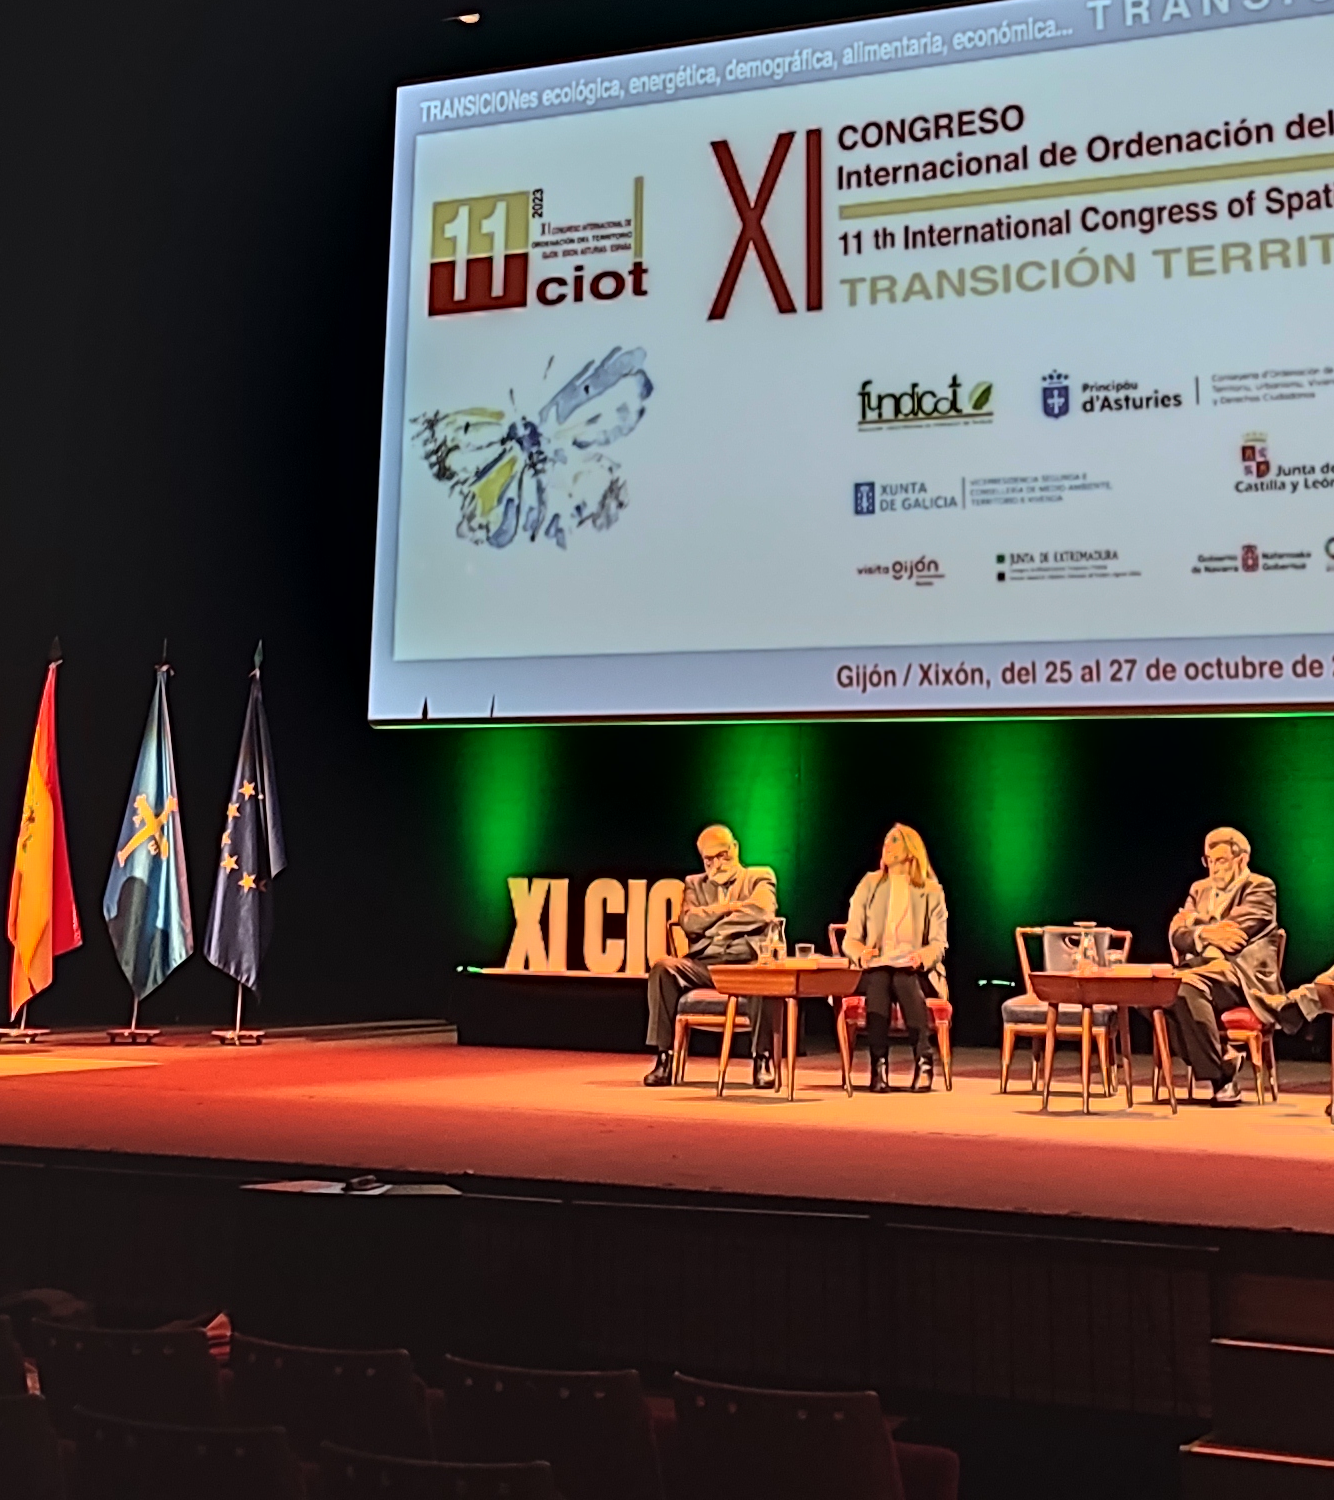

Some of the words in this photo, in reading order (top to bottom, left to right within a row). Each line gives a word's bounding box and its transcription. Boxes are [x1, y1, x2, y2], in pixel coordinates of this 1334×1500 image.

[420, 90, 538, 123] TRANSICIONes
[542, 77, 625, 106] ecológica,
[629, 65, 720, 95] energética,
[726, 48, 837, 81] demográfica,
[842, 32, 948, 65] alimentaria,
[952, 17, 1073, 49] económica...
[837, 104, 1025, 151] CONGRESO
[837, 145, 1029, 190] Internacional
[1039, 142, 1077, 169] de
[1086, 119, 1274, 162] Ordenación
[1285, 109, 1334, 140] del
[532, 188, 544, 218] 2023
[838, 230, 863, 256] 11
[873, 226, 895, 250] th
[903, 209, 1070, 250] International
[1081, 198, 1218, 234] Congress
[1227, 190, 1256, 218] of
[707, 128, 823, 321] XI
[536, 261, 648, 306] ciot
[839, 247, 1136, 307] TRANSICIÓN
[1082, 390, 1183, 413] d'Asturies
[880, 481, 928, 497] XUNTA
[1234, 479, 1287, 493] Castilla
[1290, 481, 1300, 494] y
[1275, 466, 1316, 478] Junta
[879, 499, 897, 512] DE
[902, 496, 958, 511] GALICIA
[1054, 550, 1119, 562] EXTREMADURA
[836, 663, 897, 693] Gijón
[918, 661, 992, 689] Xixón,
[1001, 660, 1037, 685] del
[1045, 660, 1072, 684] 25
[1080, 658, 1101, 683] al
[1110, 658, 1137, 682] 27
[1145, 657, 1177, 681] de
[1184, 655, 1284, 680] octubre
[1291, 653, 1324, 678] de
[504, 877, 569, 972] XI
